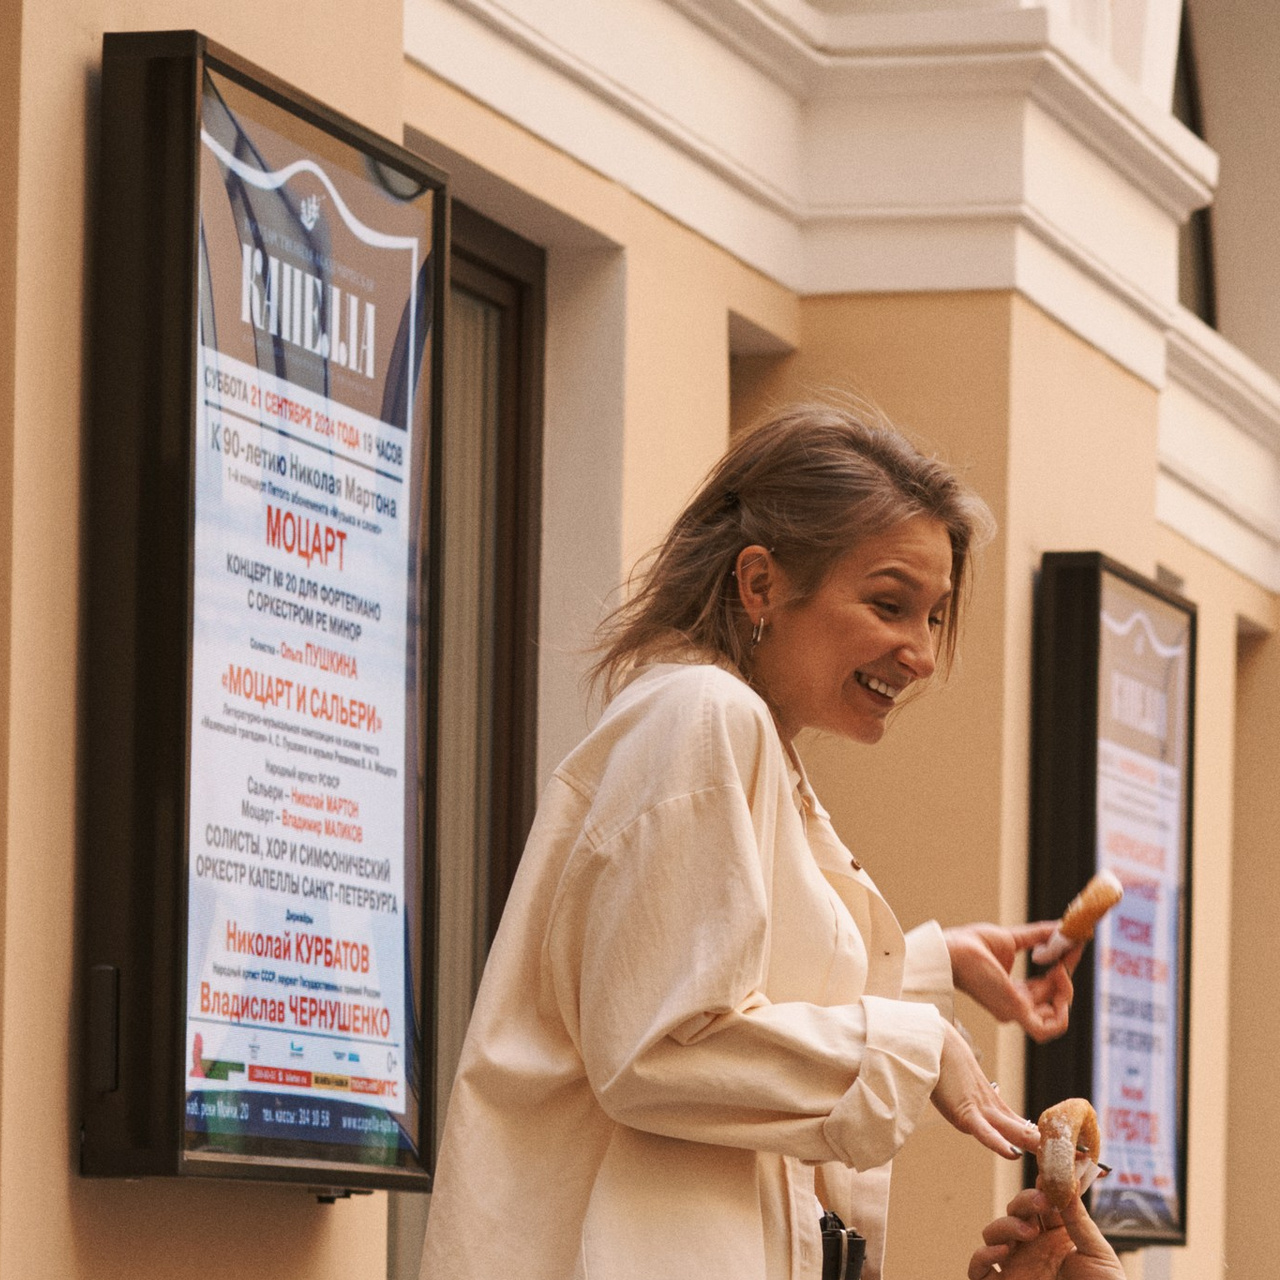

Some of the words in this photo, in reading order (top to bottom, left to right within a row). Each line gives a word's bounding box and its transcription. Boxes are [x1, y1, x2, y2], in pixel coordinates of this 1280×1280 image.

[204, 366, 248, 401] СУББОТА
[251, 385, 262, 409] 21
[265, 392, 312, 427] СЕНТЯБРЯ
[314, 411, 335, 437] 2024
[337, 421, 360, 449] ГОДА
[362, 432, 373, 454] 19
[376, 439, 403, 466] ЧАСОВ
[211, 423, 221, 452] К
[223, 428, 287, 476] 90-летию
[289, 455, 342, 496] Николая
[345, 476, 397, 519] Мартона
[266, 505, 347, 570] МОЦАРТ
[226, 554, 272, 584] КОНЦЕРТ
[273, 569, 284, 588] №
[285, 572, 297, 594] 20
[298, 577, 319, 599] ДЛЯ
[320, 585, 381, 621] ФОРТЕПИАНО
[247, 589, 255, 609] С
[256, 592, 314, 625] ОРКЕСТРОМ
[315, 611, 328, 632] РЕ
[329, 616, 362, 640] МИНОР
[280, 641, 303, 664] Ольга
[305, 642, 357, 678] ПУШКИНА
[222, 664, 293, 709] «МОЦАРТ
[296, 684, 307, 714] И
[310, 688, 382, 732] САЛЬЕРИ»
[241, 799, 274, 825] Моцарт
[281, 809, 322, 836] Владимир
[324, 819, 363, 843] МАЛИКОВ
[247, 775, 284, 802] Сальери
[291, 787, 324, 810] Николай
[326, 795, 359, 818] МАРТОН
[205, 823, 264, 859] СОЛИСТЫ,
[266, 837, 288, 860] ХОР
[289, 842, 298, 863] И
[299, 845, 391, 882] СИМФОНИЧЕСКИЙ
[196, 855, 247, 883] ОРКЕСТР
[248, 866, 300, 895] КАПЕЛЛЫ
[302, 877, 398, 914] САНКТ-ПЕТЕРБУРГА
[227, 922, 292, 961] Николай
[295, 933, 369, 973] КУРБАТОВ
[200, 982, 285, 1024] Владислав
[289, 995, 390, 1036] ЧЕРНУШЕНКО
[386, 1051, 398, 1073] 0+
